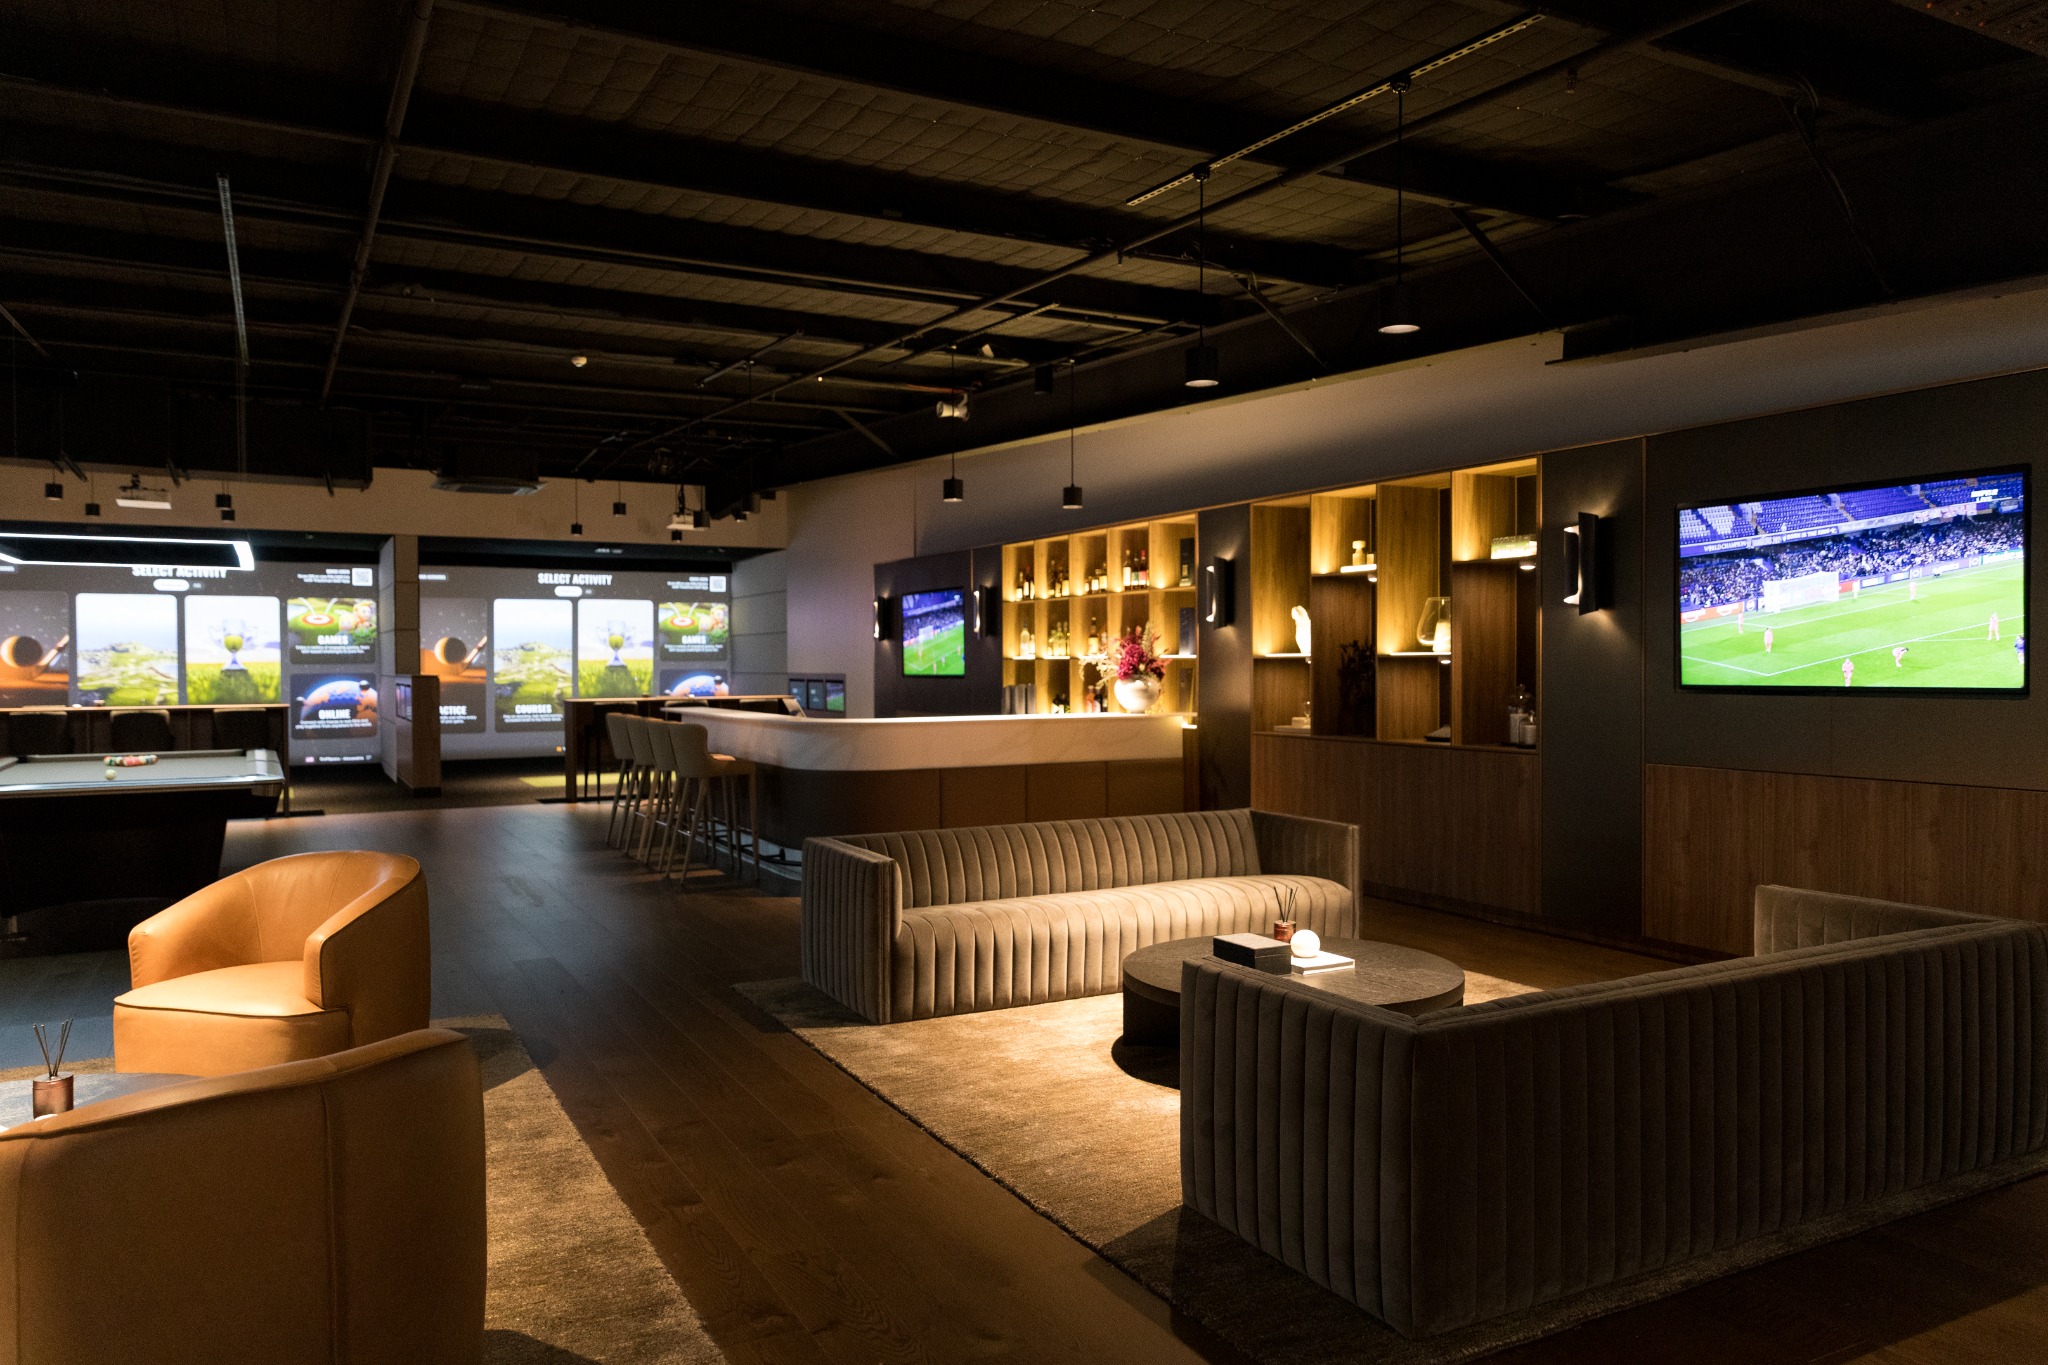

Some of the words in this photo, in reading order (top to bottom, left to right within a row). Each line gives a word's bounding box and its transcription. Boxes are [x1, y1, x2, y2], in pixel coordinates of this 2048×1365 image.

[132, 566, 173, 577] SELECT
[176, 567, 227, 578] ACTIVITY
[537, 572, 571, 584] SELECT
[572, 574, 613, 586] ACTIVITY
[317, 634, 349, 645] GAMES
[681, 634, 707, 645] GAMES
[318, 708, 351, 720] ONLINE
[438, 705, 467, 715] ACTICE
[515, 703, 553, 714] COURSES
